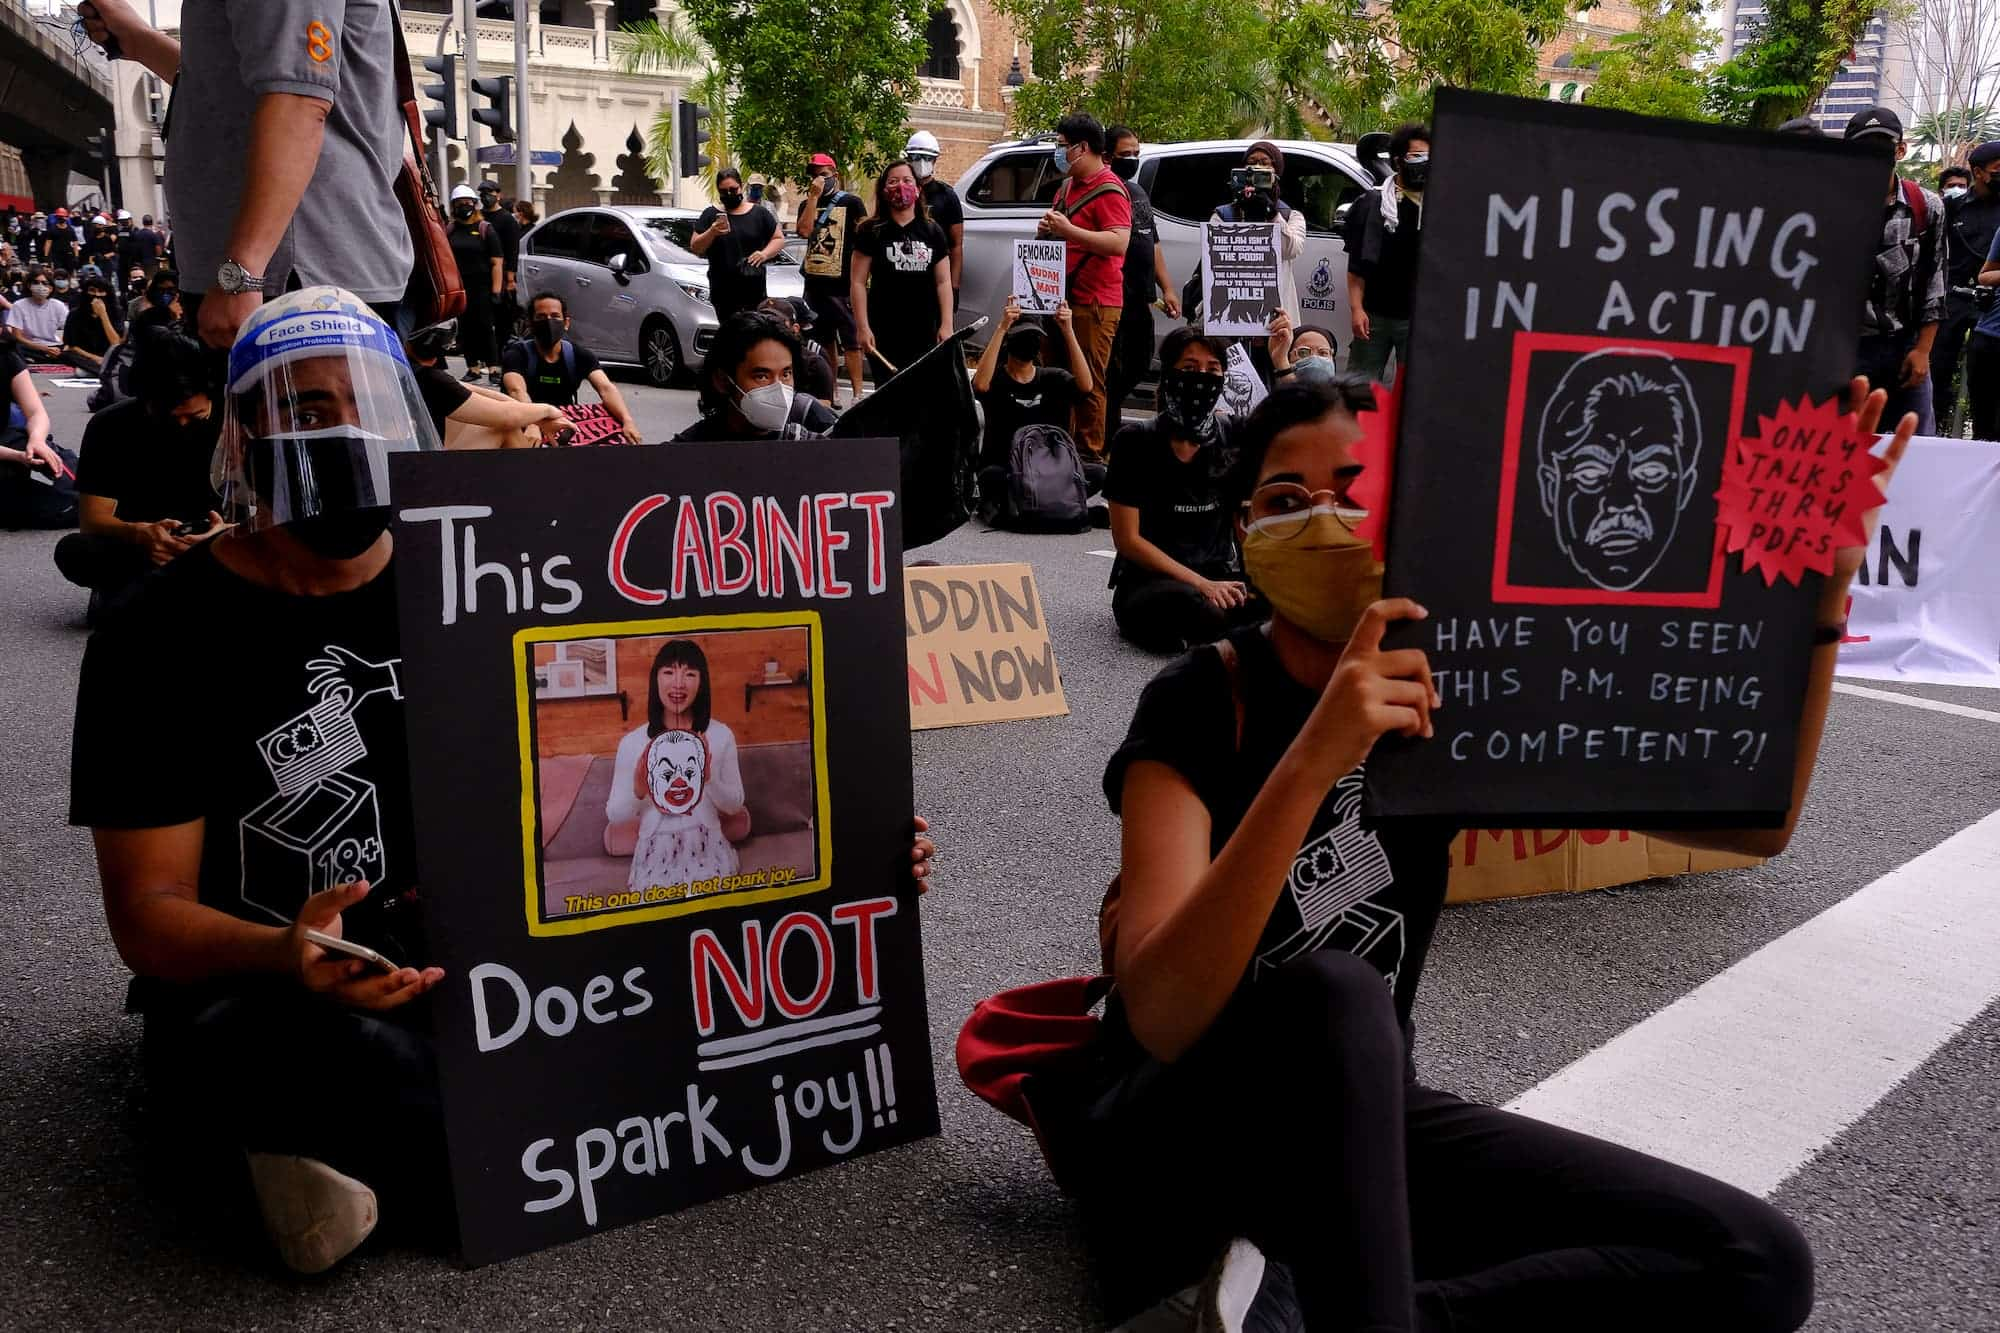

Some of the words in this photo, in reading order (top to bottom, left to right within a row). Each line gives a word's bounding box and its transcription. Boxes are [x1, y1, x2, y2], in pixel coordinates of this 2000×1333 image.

[1018, 244, 1062, 261] DEMOKRASI
[1213, 236, 1228, 244] THE
[1230, 236, 1247, 245] LAW
[1220, 253, 1236, 261] THE
[1485, 188, 1818, 290] MISSING
[1030, 267, 1059, 282] SUDAH
[1036, 282, 1060, 296] MATI
[1228, 287, 1264, 300] RULE!
[1303, 299, 1334, 309] POLIS
[1464, 281, 1538, 340] IN
[1598, 280, 1815, 354] ACTION
[268, 324, 305, 341] Face
[310, 320, 361, 332] Shield
[1773, 425, 1858, 462] ONLY
[1747, 453, 1853, 494] TALKS
[1748, 487, 1847, 527] THRU
[400, 505, 583, 624] This
[608, 491, 896, 605] CABINET
[906, 576, 1038, 637] DDIN
[1436, 616, 1535, 651] HAVE
[1565, 616, 1629, 655] YOU
[1661, 620, 1763, 654] SEEN
[951, 642, 1056, 704] NOW
[1432, 668, 1521, 707] THIS
[1560, 667, 1623, 701] P.M.
[1650, 672, 1763, 711] BEING
[317, 837, 381, 891] 18+
[565, 894, 603, 913] This
[608, 890, 641, 908] one
[644, 883, 688, 903] does
[691, 877, 719, 894] not
[721, 868, 766, 892] spark
[469, 962, 653, 1052] Does
[690, 897, 897, 1036] NOT
[521, 1083, 732, 1226] spark
[741, 1043, 897, 1177] joy!!
